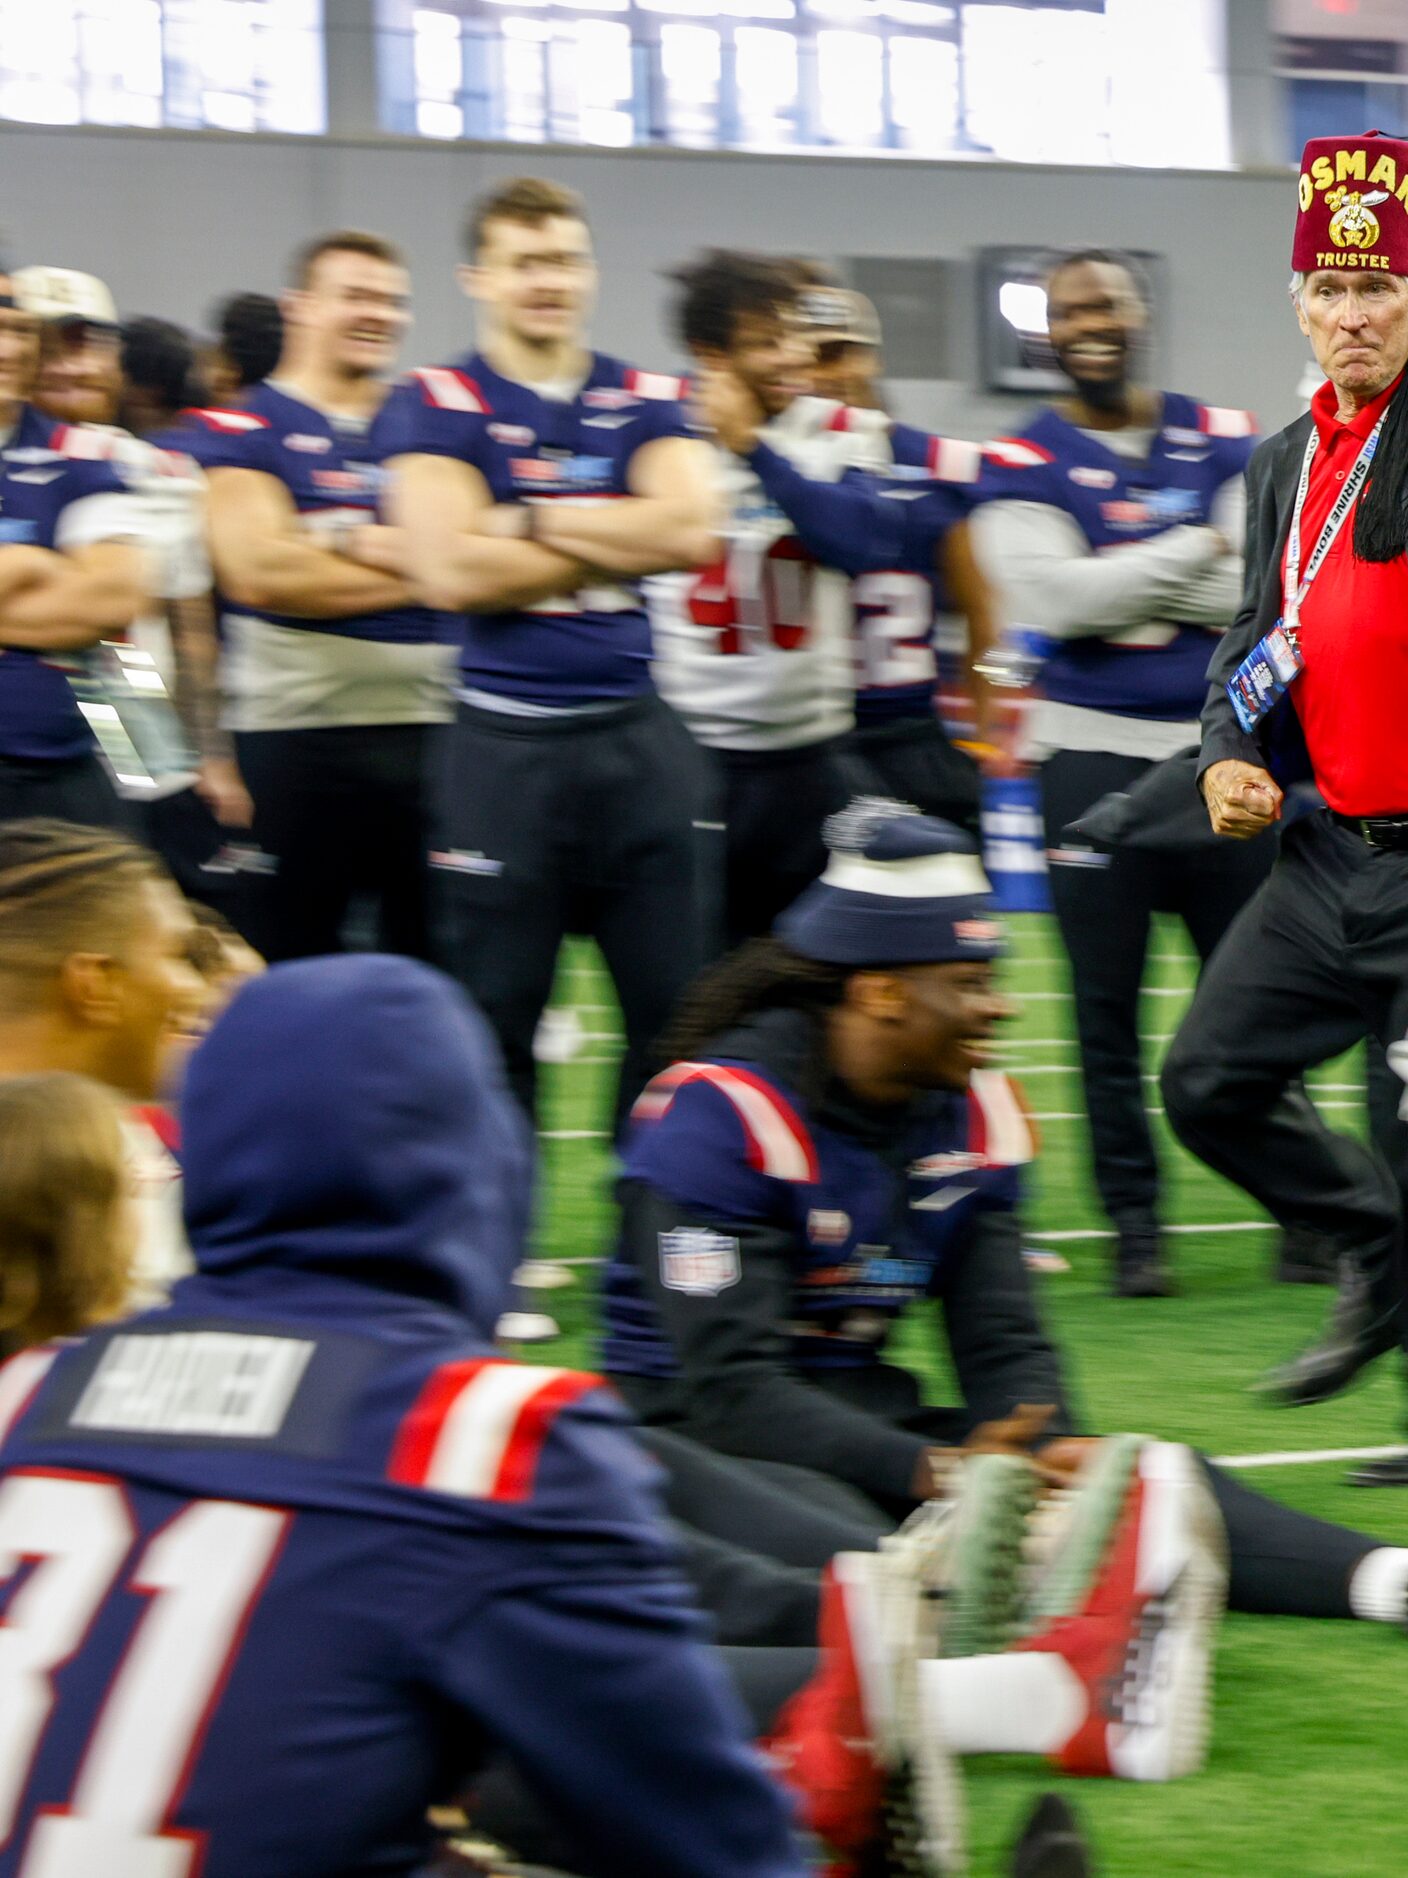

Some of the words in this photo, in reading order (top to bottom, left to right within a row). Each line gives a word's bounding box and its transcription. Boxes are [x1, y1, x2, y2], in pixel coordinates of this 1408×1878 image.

[1315, 252, 1391, 270] TRUSTEE
[1331, 461, 1367, 523] SHRINE
[1308, 527, 1334, 571] BOWL
